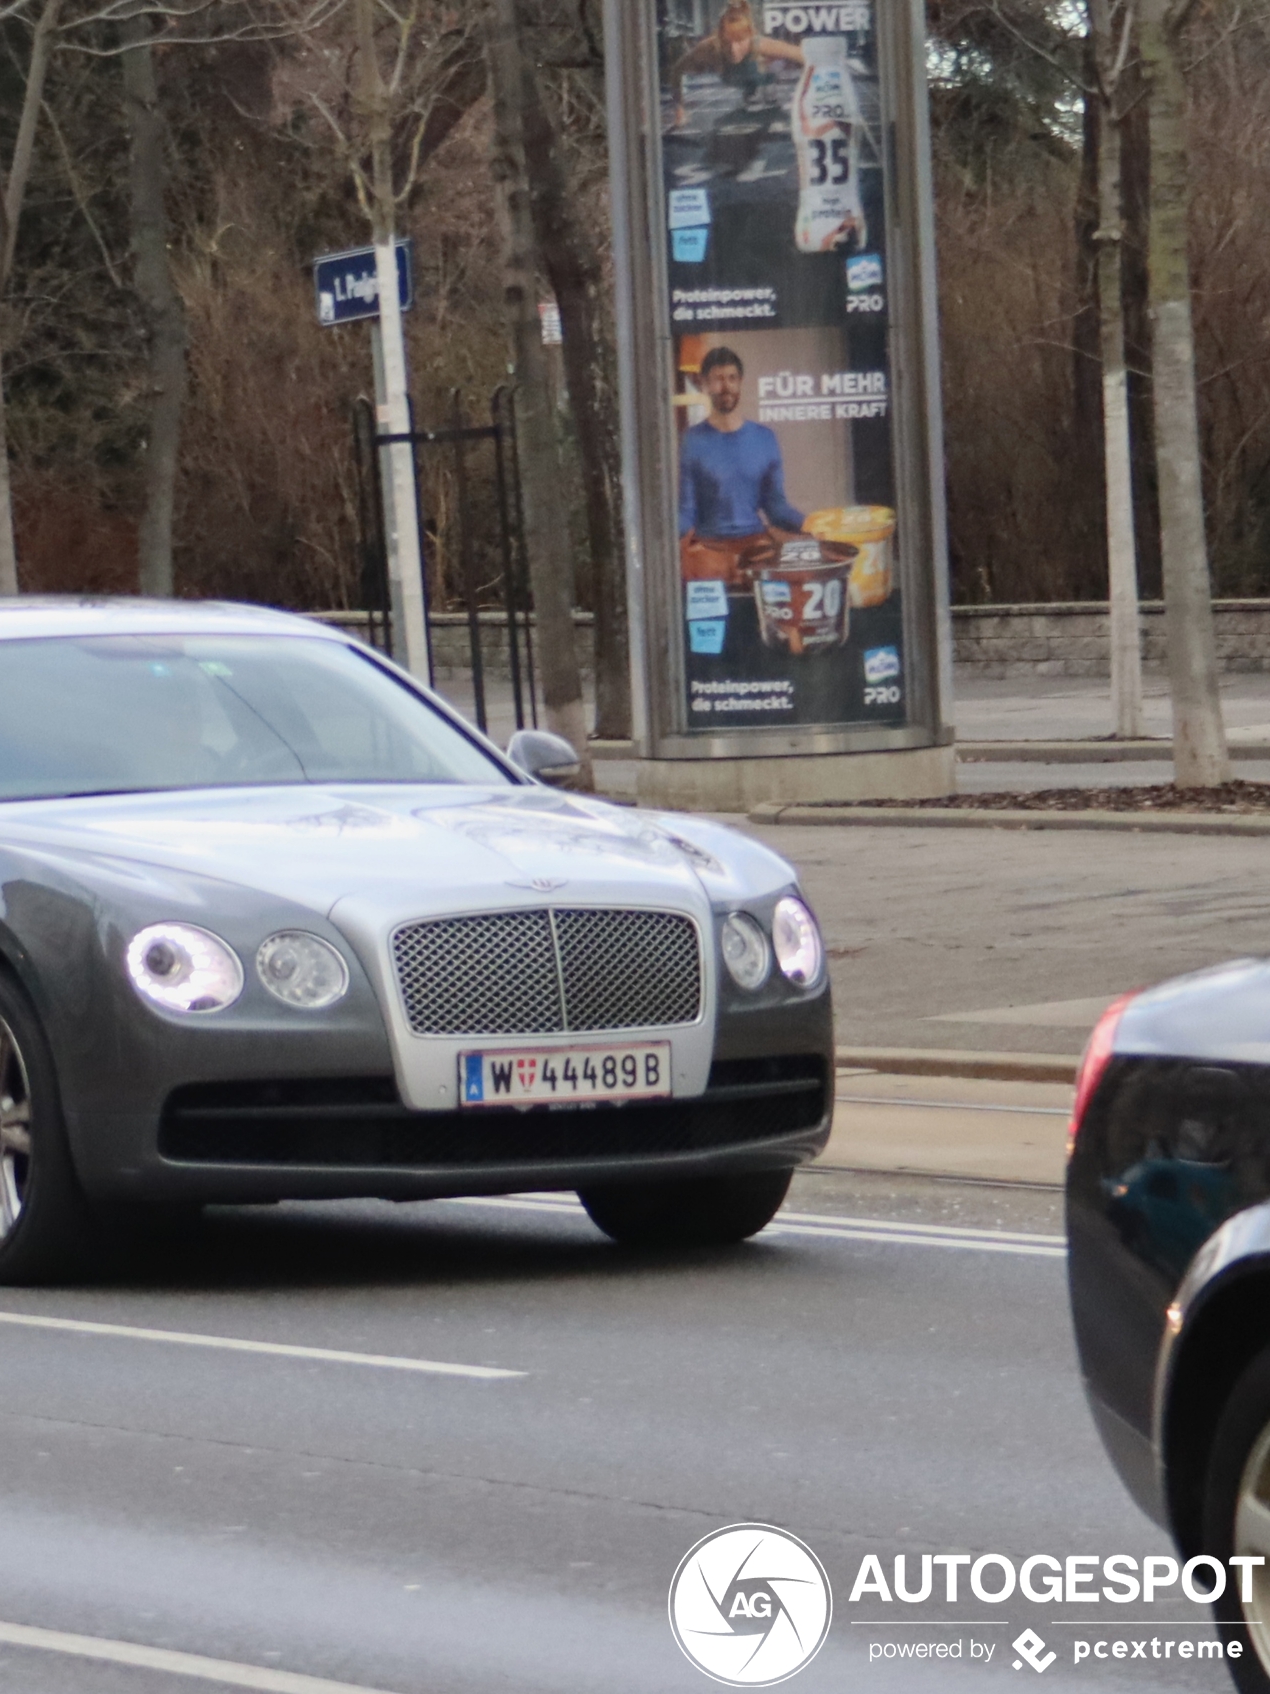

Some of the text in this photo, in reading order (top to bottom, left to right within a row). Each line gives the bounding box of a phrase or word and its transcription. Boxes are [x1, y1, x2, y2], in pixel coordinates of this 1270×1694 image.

[764, 6, 871, 34] POWER
[808, 139, 849, 186] 35
[672, 287, 777, 305] Proteinpower,
[846, 294, 885, 314] PRO
[672, 303, 777, 321] die schmeckt.
[759, 371, 886, 398] FÜR MEHR
[758, 402, 887, 422] INNERE KRAFT
[801, 579, 842, 619] 20
[690, 680, 794, 696] Proteinpower,
[863, 686, 901, 705] PRO
[691, 697, 794, 712] die schmeckt.
[491, 1053, 660, 1094] W 44489B
[469, 1083, 479, 1096] A
